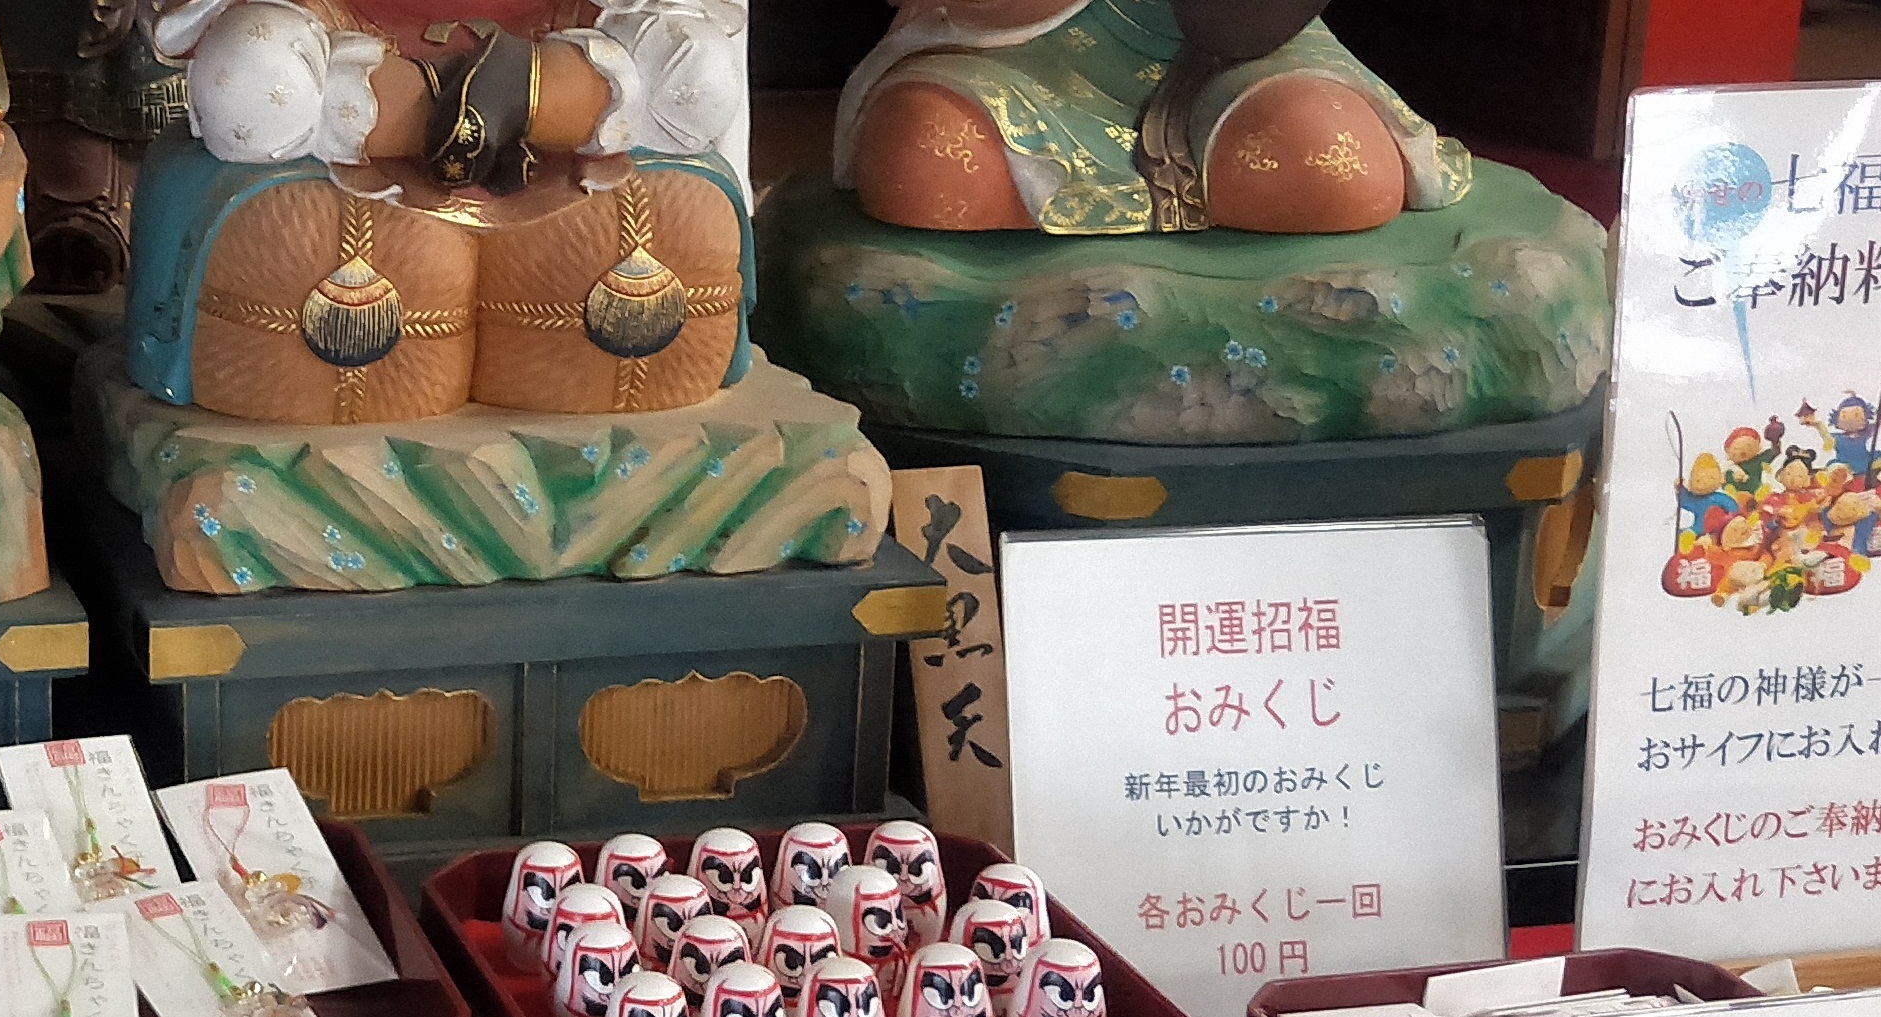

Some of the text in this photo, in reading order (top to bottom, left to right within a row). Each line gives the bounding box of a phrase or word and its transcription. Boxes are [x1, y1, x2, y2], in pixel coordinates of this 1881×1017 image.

[1677, 558, 1712, 589] 福
[921, 494, 1003, 768] 大黒天
[1158, 597, 1341, 658] 開運招福
[1164, 677, 1341, 736] おみくじ
[1124, 762, 1385, 801] 新年最初のおみくじ
[1138, 883, 1383, 931] 各おみくじ一回
